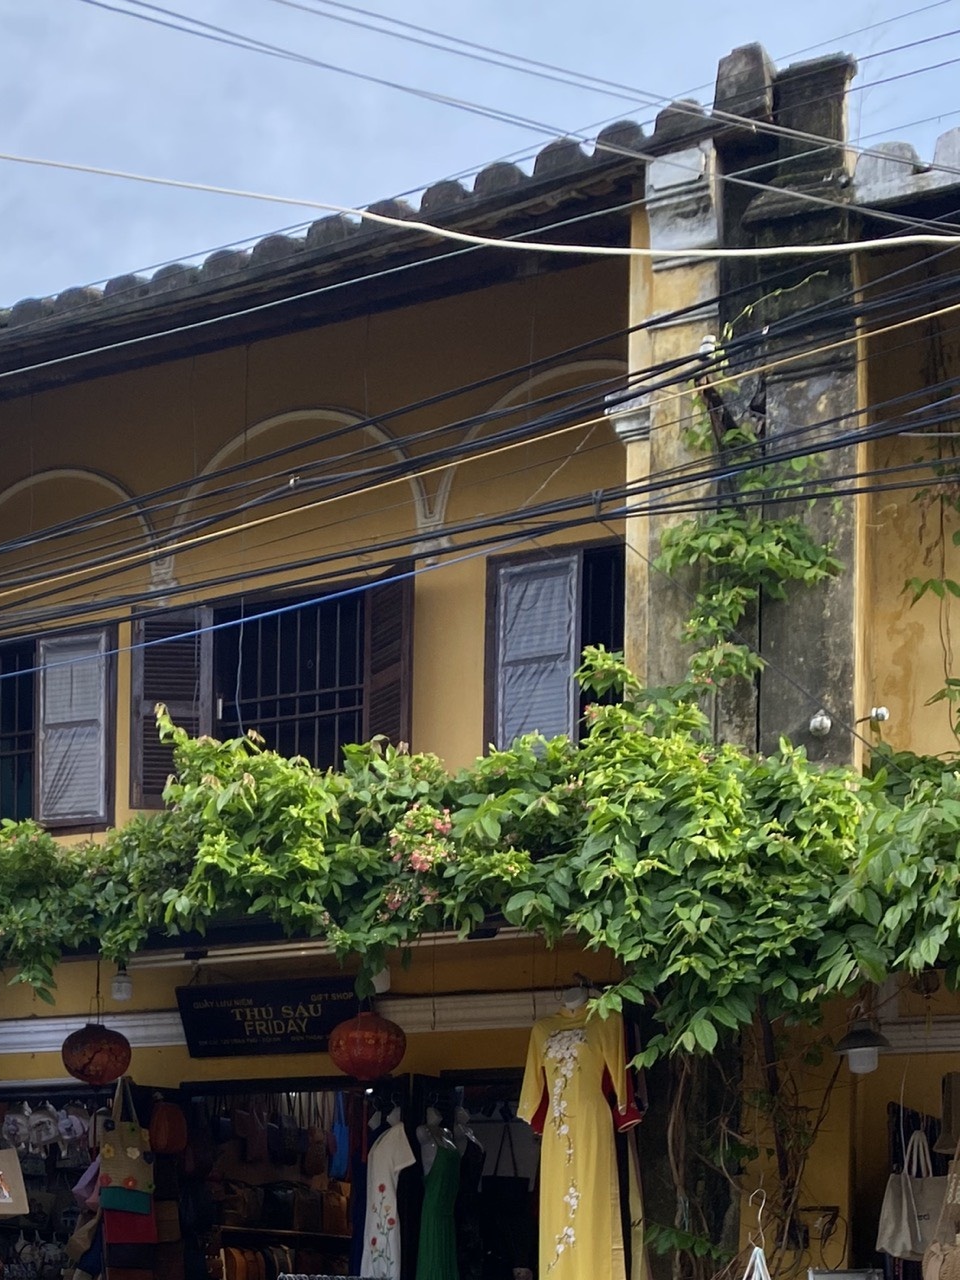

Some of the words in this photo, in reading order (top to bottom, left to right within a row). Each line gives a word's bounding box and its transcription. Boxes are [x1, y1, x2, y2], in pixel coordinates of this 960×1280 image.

[310, 993, 329, 1002] GIFT
[331, 991, 354, 1001] SHOP
[244, 1018, 309, 1036] FRIDAY
